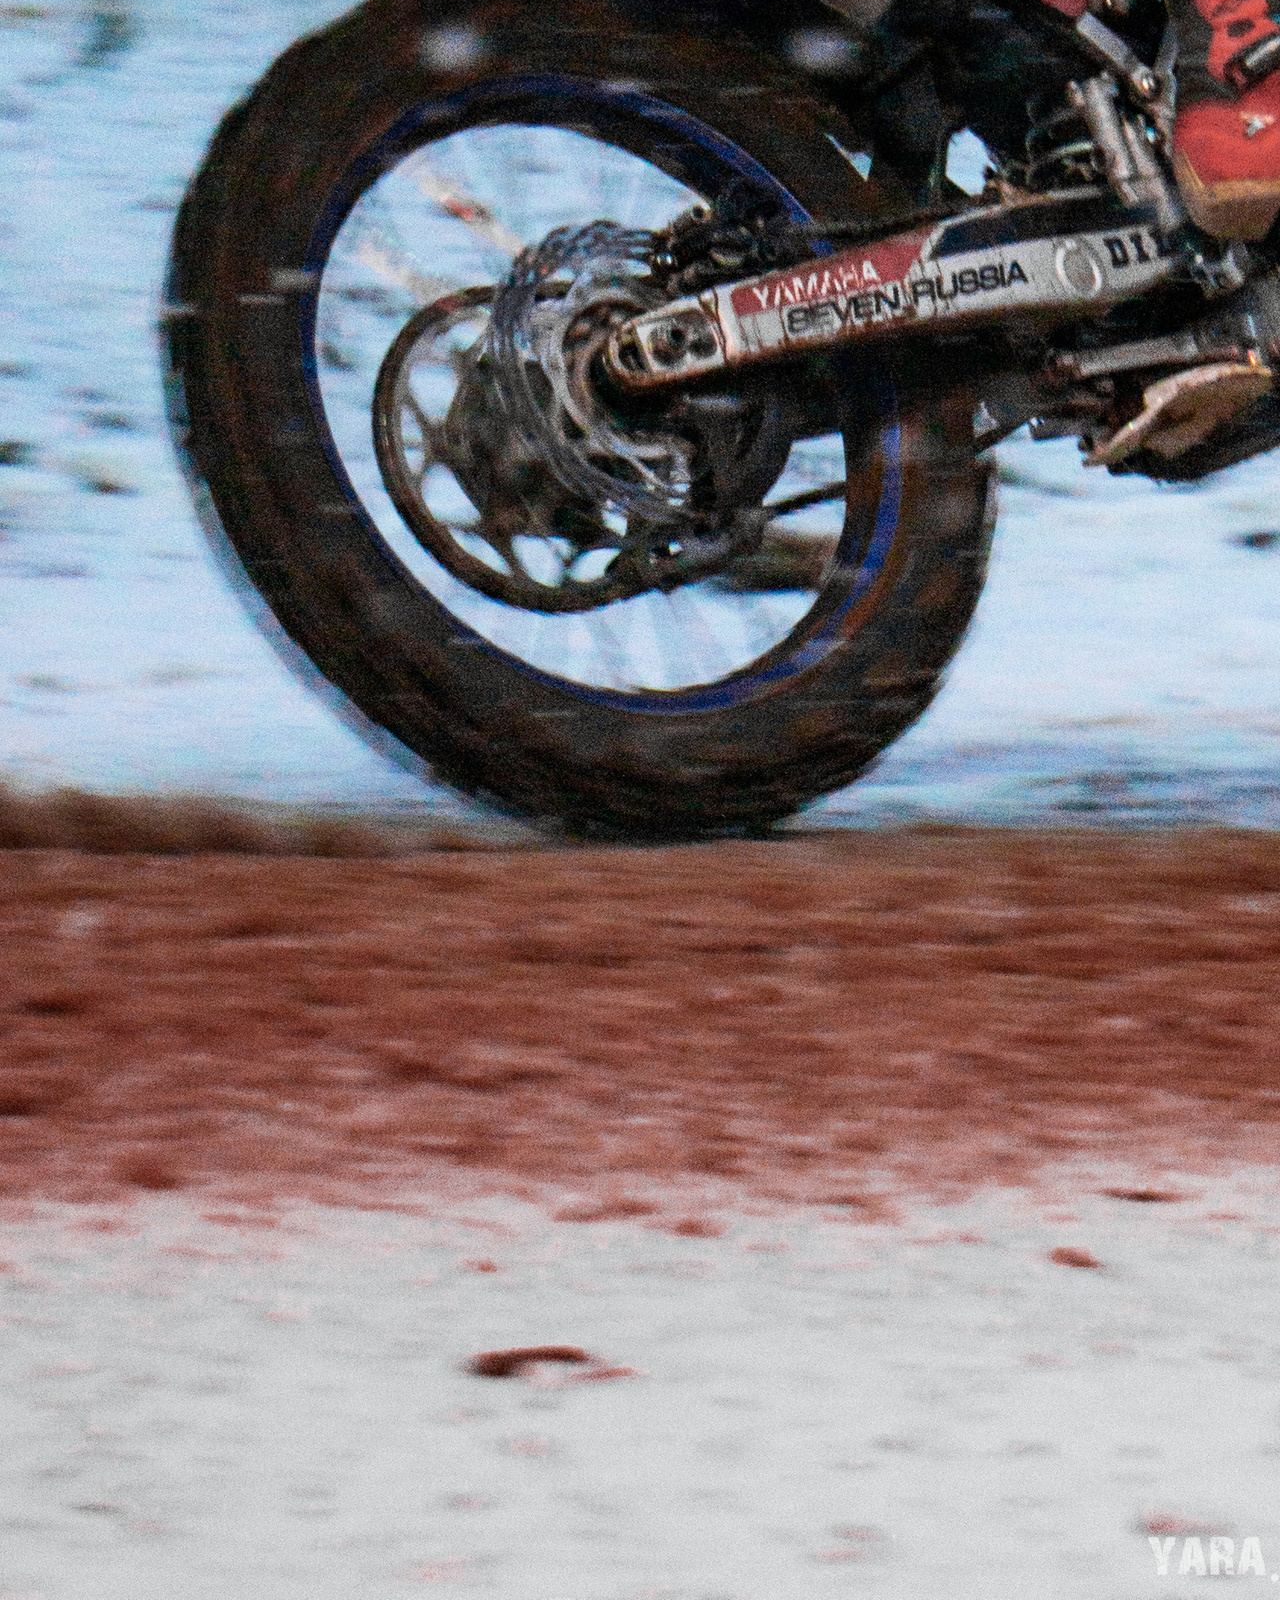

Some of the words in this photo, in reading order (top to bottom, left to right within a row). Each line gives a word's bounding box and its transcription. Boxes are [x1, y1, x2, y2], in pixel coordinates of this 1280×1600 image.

[752, 259, 881, 309] YAMAHA
[787, 288, 899, 335] SEVEN
[911, 259, 1029, 305] RUSSIA
